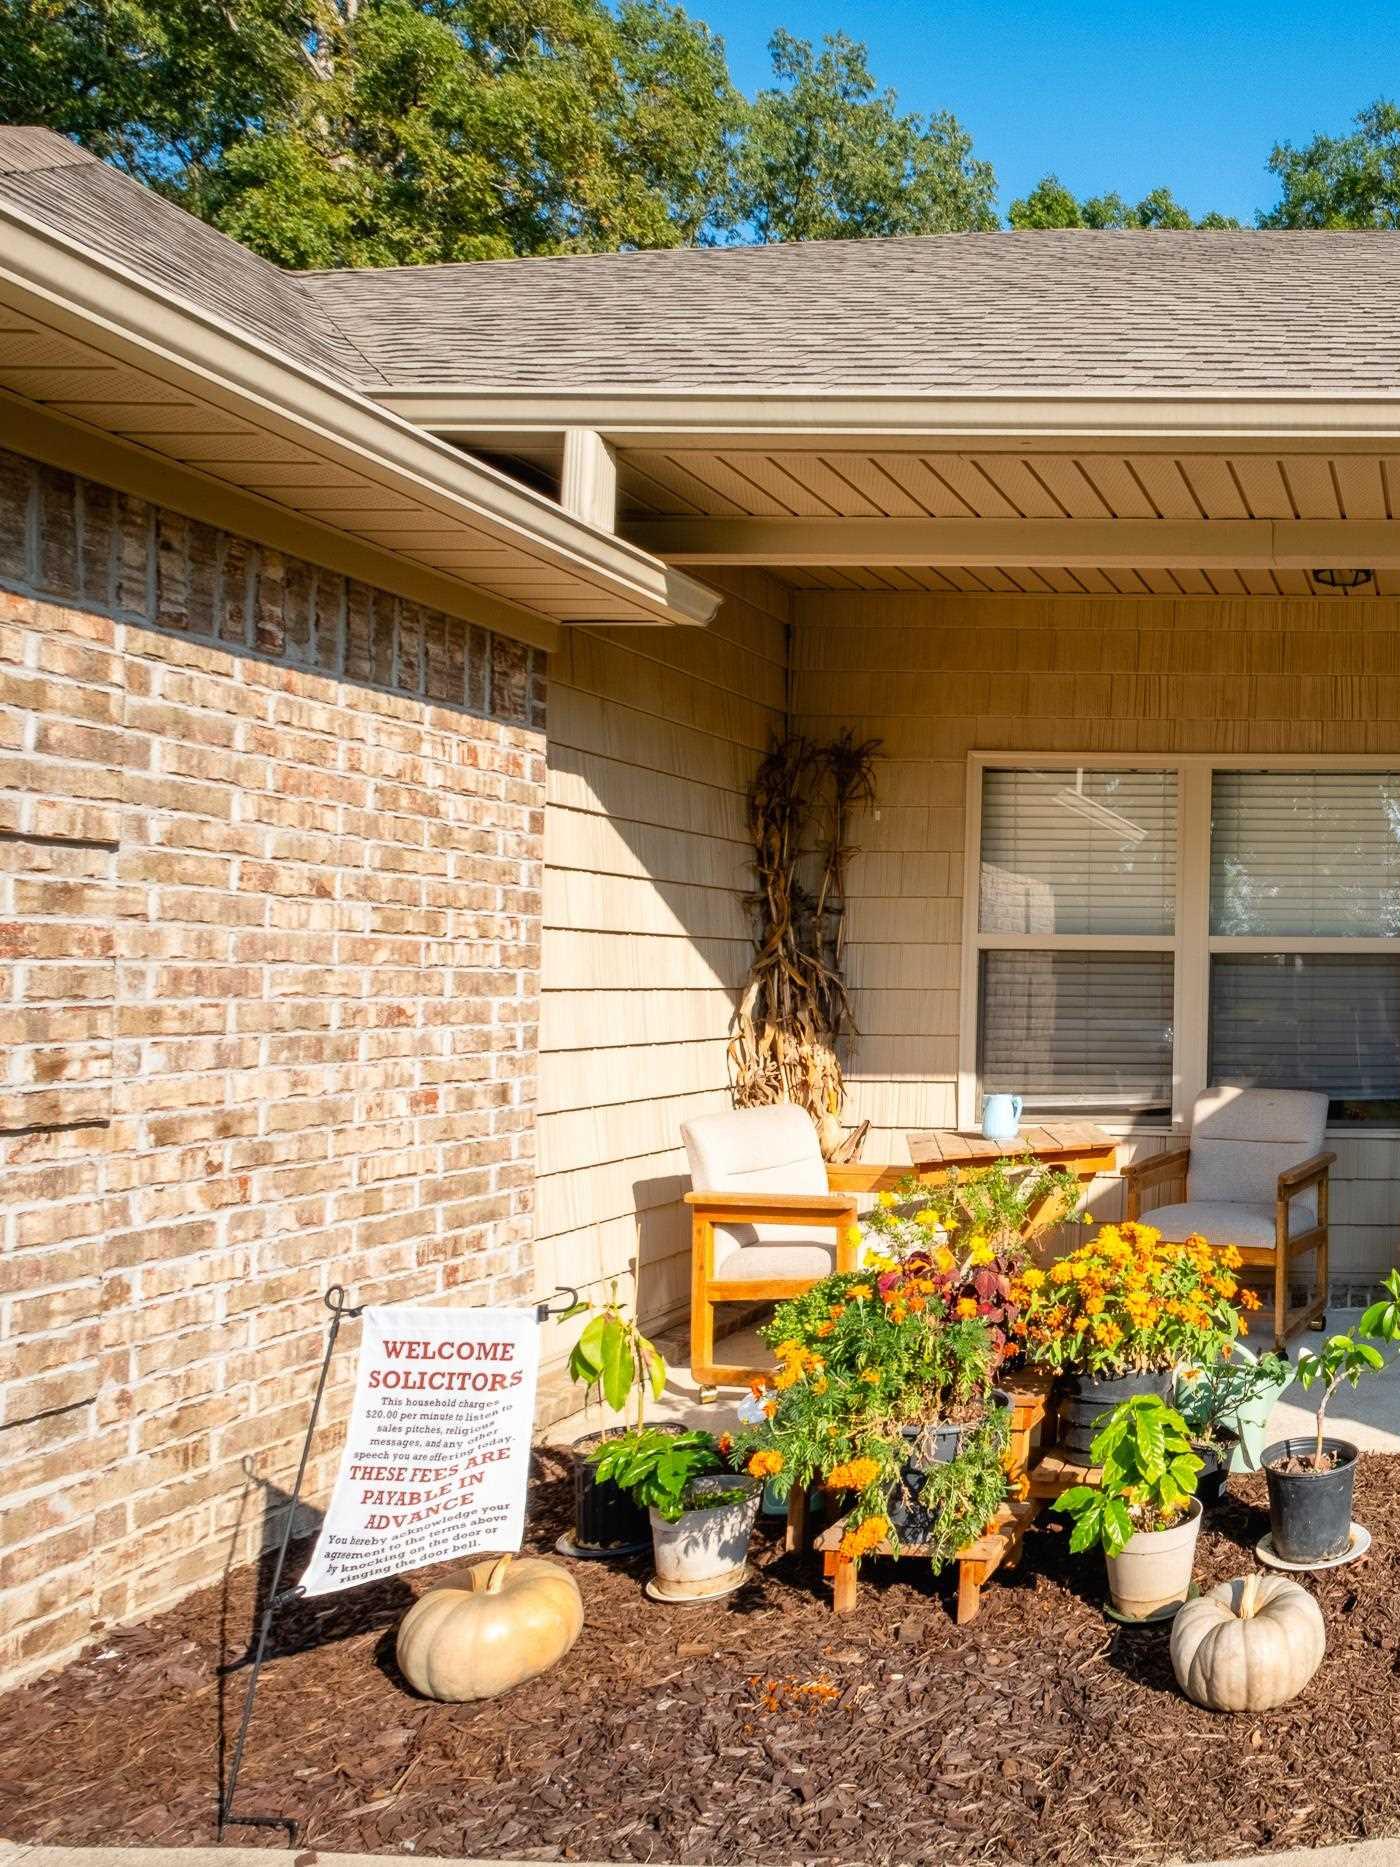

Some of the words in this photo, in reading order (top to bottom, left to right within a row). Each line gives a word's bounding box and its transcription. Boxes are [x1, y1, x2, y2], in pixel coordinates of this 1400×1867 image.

[383, 1340, 515, 1361] WELCOME
[368, 1370, 523, 1391] SOLICITORS
[366, 1410, 398, 1419] $20.00
[400, 1412, 417, 1421] per
[419, 1412, 453, 1421] minute
[465, 1410, 499, 1422] listen
[502, 1404, 513, 1412] to
[381, 1397, 402, 1406] This
[406, 1397, 456, 1407] household
[459, 1399, 500, 1410] charges
[370, 1438, 423, 1449] messages,
[425, 1439, 441, 1447] and
[443, 1441, 463, 1449] any
[467, 1429, 499, 1445] other
[377, 1424, 402, 1433] sales
[405, 1425, 443, 1435] pitches,
[445, 1420, 495, 1437] religious
[353, 1451, 390, 1461] speech
[392, 1452, 410, 1462] you
[429, 1448, 475, 1462] offering
[477, 1434, 517, 1450] today.
[349, 1465, 407, 1482] THESE
[409, 1464, 460, 1483] FEES
[465, 1447, 512, 1470] ARE
[360, 1482, 452, 1506] PAYABLE
[457, 1471, 485, 1490] IN
[328, 1534, 348, 1545] You
[349, 1534, 388, 1546] hereby
[391, 1508, 478, 1542] acknowledge
[481, 1502, 511, 1515] your
[364, 1492, 475, 1530] ADVANCE
[324, 1547, 386, 1560] agreement
[389, 1542, 402, 1551] to
[405, 1534, 426, 1547] the
[429, 1523, 467, 1538] terms
[470, 1514, 508, 1527] above
[325, 1563, 338, 1576] by
[341, 1552, 406, 1573] knocking
[409, 1545, 426, 1555] on
[428, 1537, 449, 1549] the
[452, 1529, 481, 1542] door
[485, 1526, 499, 1535] or
[339, 1564, 392, 1584] ringing
[395, 1557, 417, 1569] the
[419, 1548, 449, 1562] door
[452, 1541, 481, 1552] bell.
